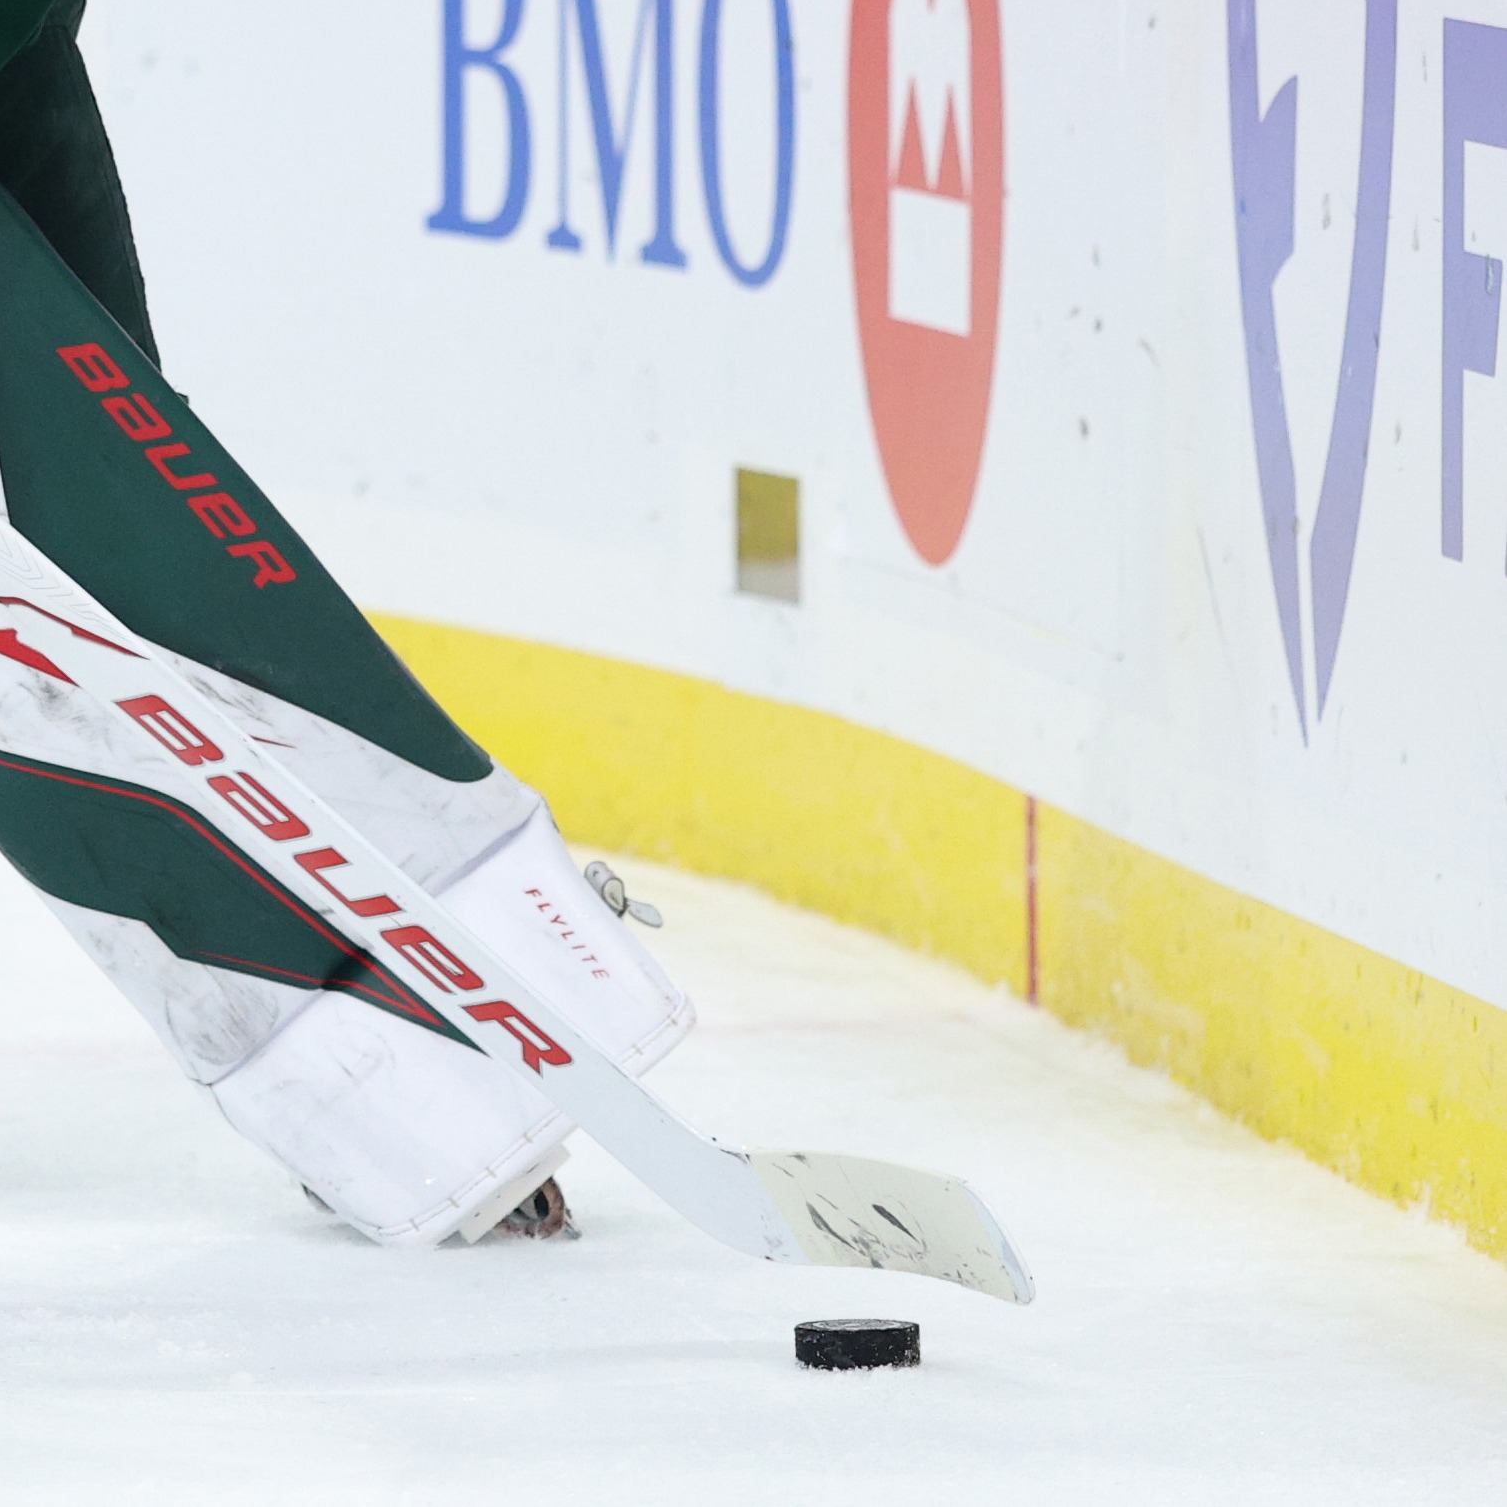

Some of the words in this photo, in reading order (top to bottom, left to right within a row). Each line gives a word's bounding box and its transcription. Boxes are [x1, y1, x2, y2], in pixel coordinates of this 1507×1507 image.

[55, 342, 297, 589] BAUER
[115, 694, 574, 1078] BAUER
[524, 888, 610, 979] FLYLITE
